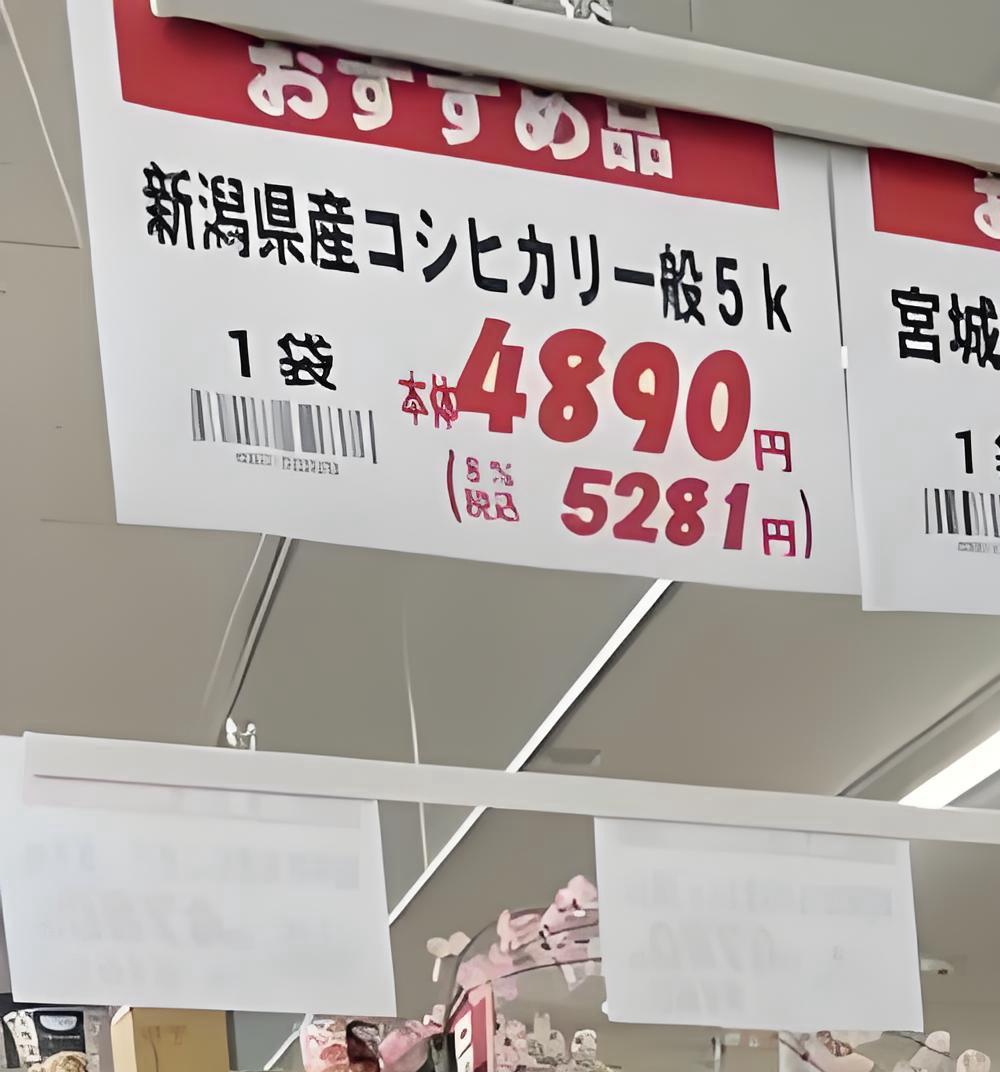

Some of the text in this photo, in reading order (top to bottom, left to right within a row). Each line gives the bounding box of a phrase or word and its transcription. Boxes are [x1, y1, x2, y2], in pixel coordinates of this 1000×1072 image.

[247, 40, 674, 179] おすすめ品
